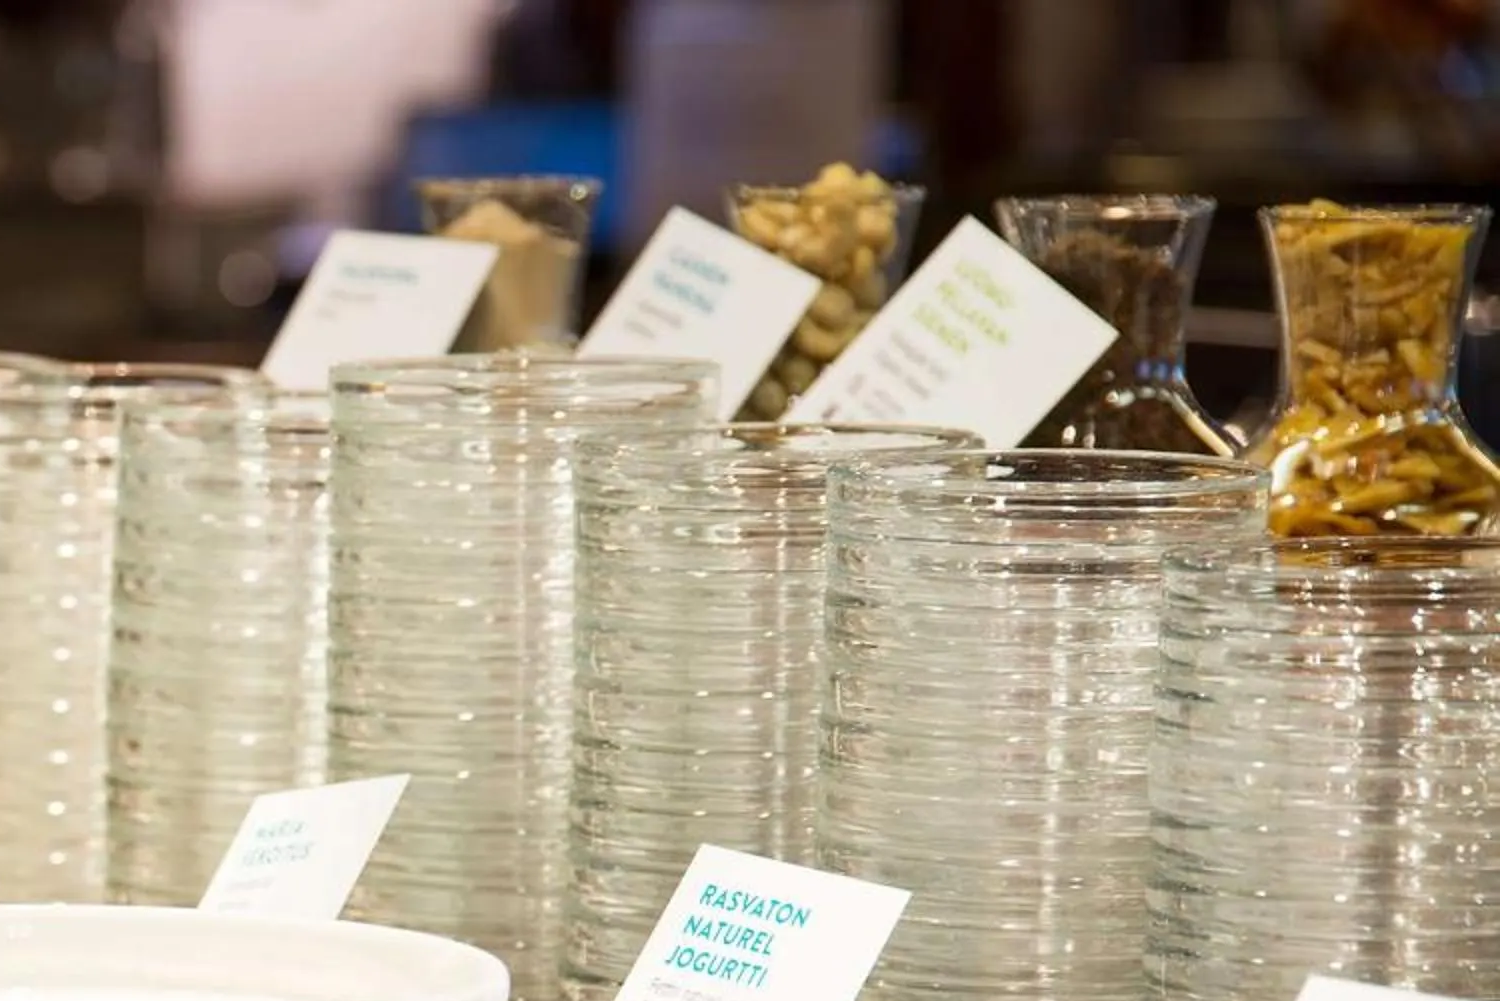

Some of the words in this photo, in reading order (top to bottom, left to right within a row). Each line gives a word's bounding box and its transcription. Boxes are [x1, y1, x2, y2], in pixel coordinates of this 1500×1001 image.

[700, 884, 811, 929] RASVATON
[684, 914, 776, 956] NATUREL
[665, 945, 769, 988] JOGURTTI
